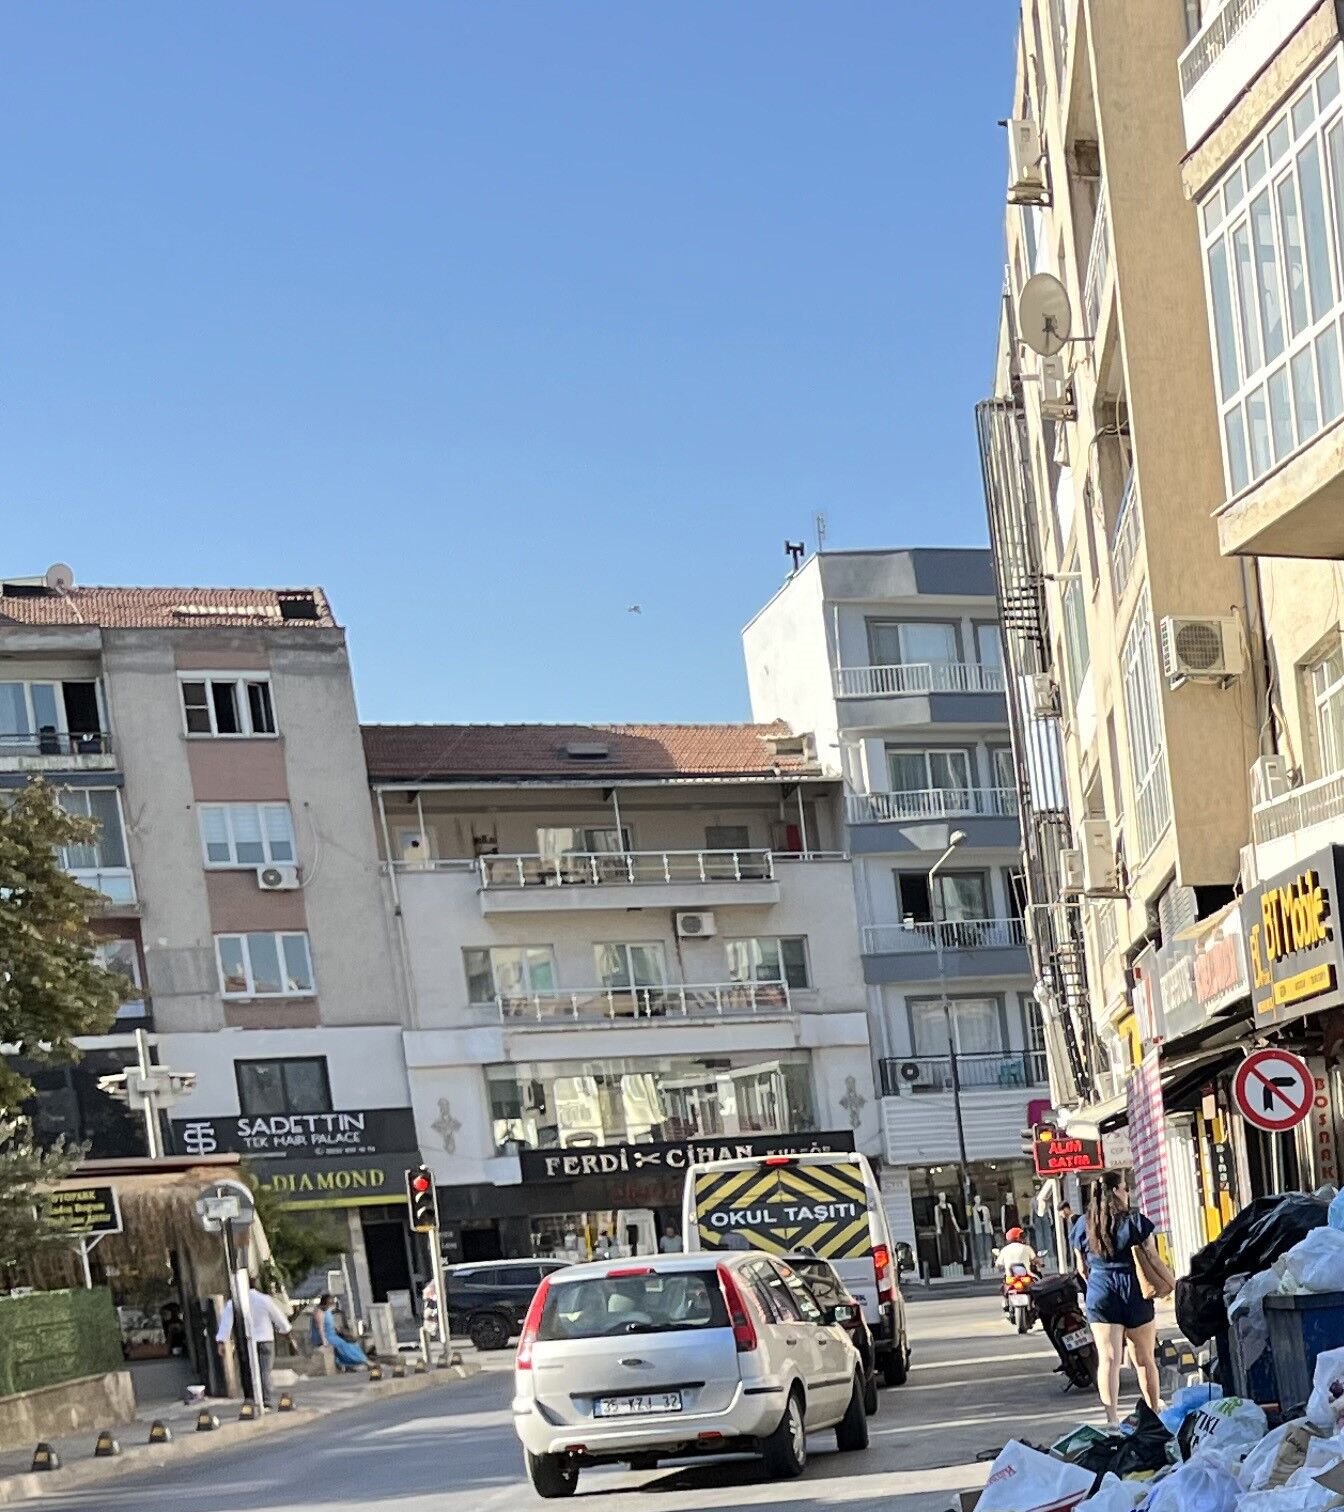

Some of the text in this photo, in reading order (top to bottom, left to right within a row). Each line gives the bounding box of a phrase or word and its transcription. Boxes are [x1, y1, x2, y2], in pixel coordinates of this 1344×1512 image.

[311, 1131, 361, 1145] PALACE
[545, 1148, 629, 1176] FERDİ
[666, 1144, 753, 1169] CİHAN
[711, 1203, 856, 1228] OKUL TAŞITI
